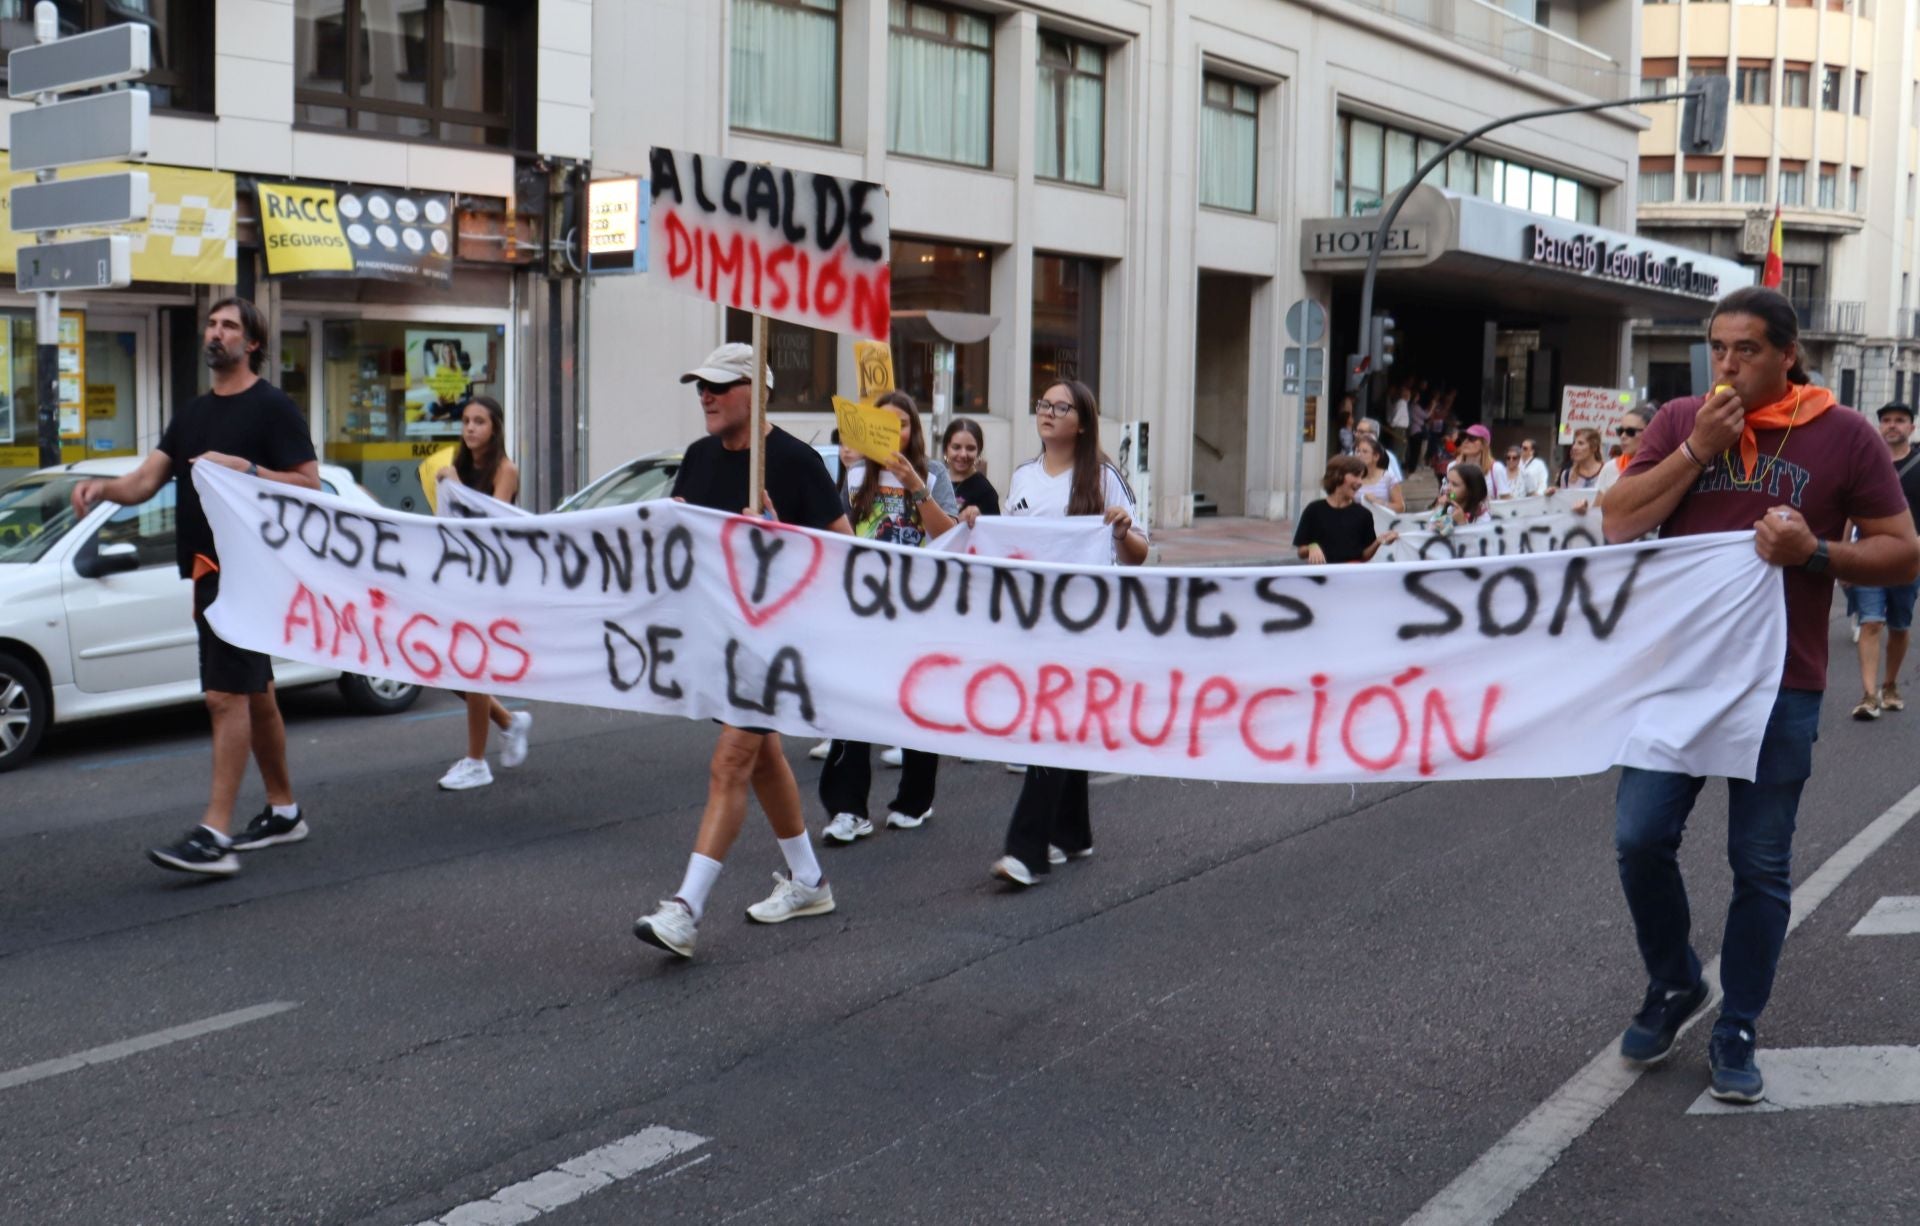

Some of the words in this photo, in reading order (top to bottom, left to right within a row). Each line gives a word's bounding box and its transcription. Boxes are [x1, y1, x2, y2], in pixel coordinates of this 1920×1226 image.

[266, 192, 334, 223] RACC
[268, 233, 344, 249] SEGUROS
[650, 147, 883, 262] ALCALDE
[1315, 229, 1420, 253] HOTEL
[664, 208, 890, 341] DIMISIÓN
[257, 491, 406, 578] JOSE
[749, 527, 784, 603] Y
[1397, 548, 1661, 639] SON
[603, 620, 683, 700] DE
[725, 638, 815, 723] LA
